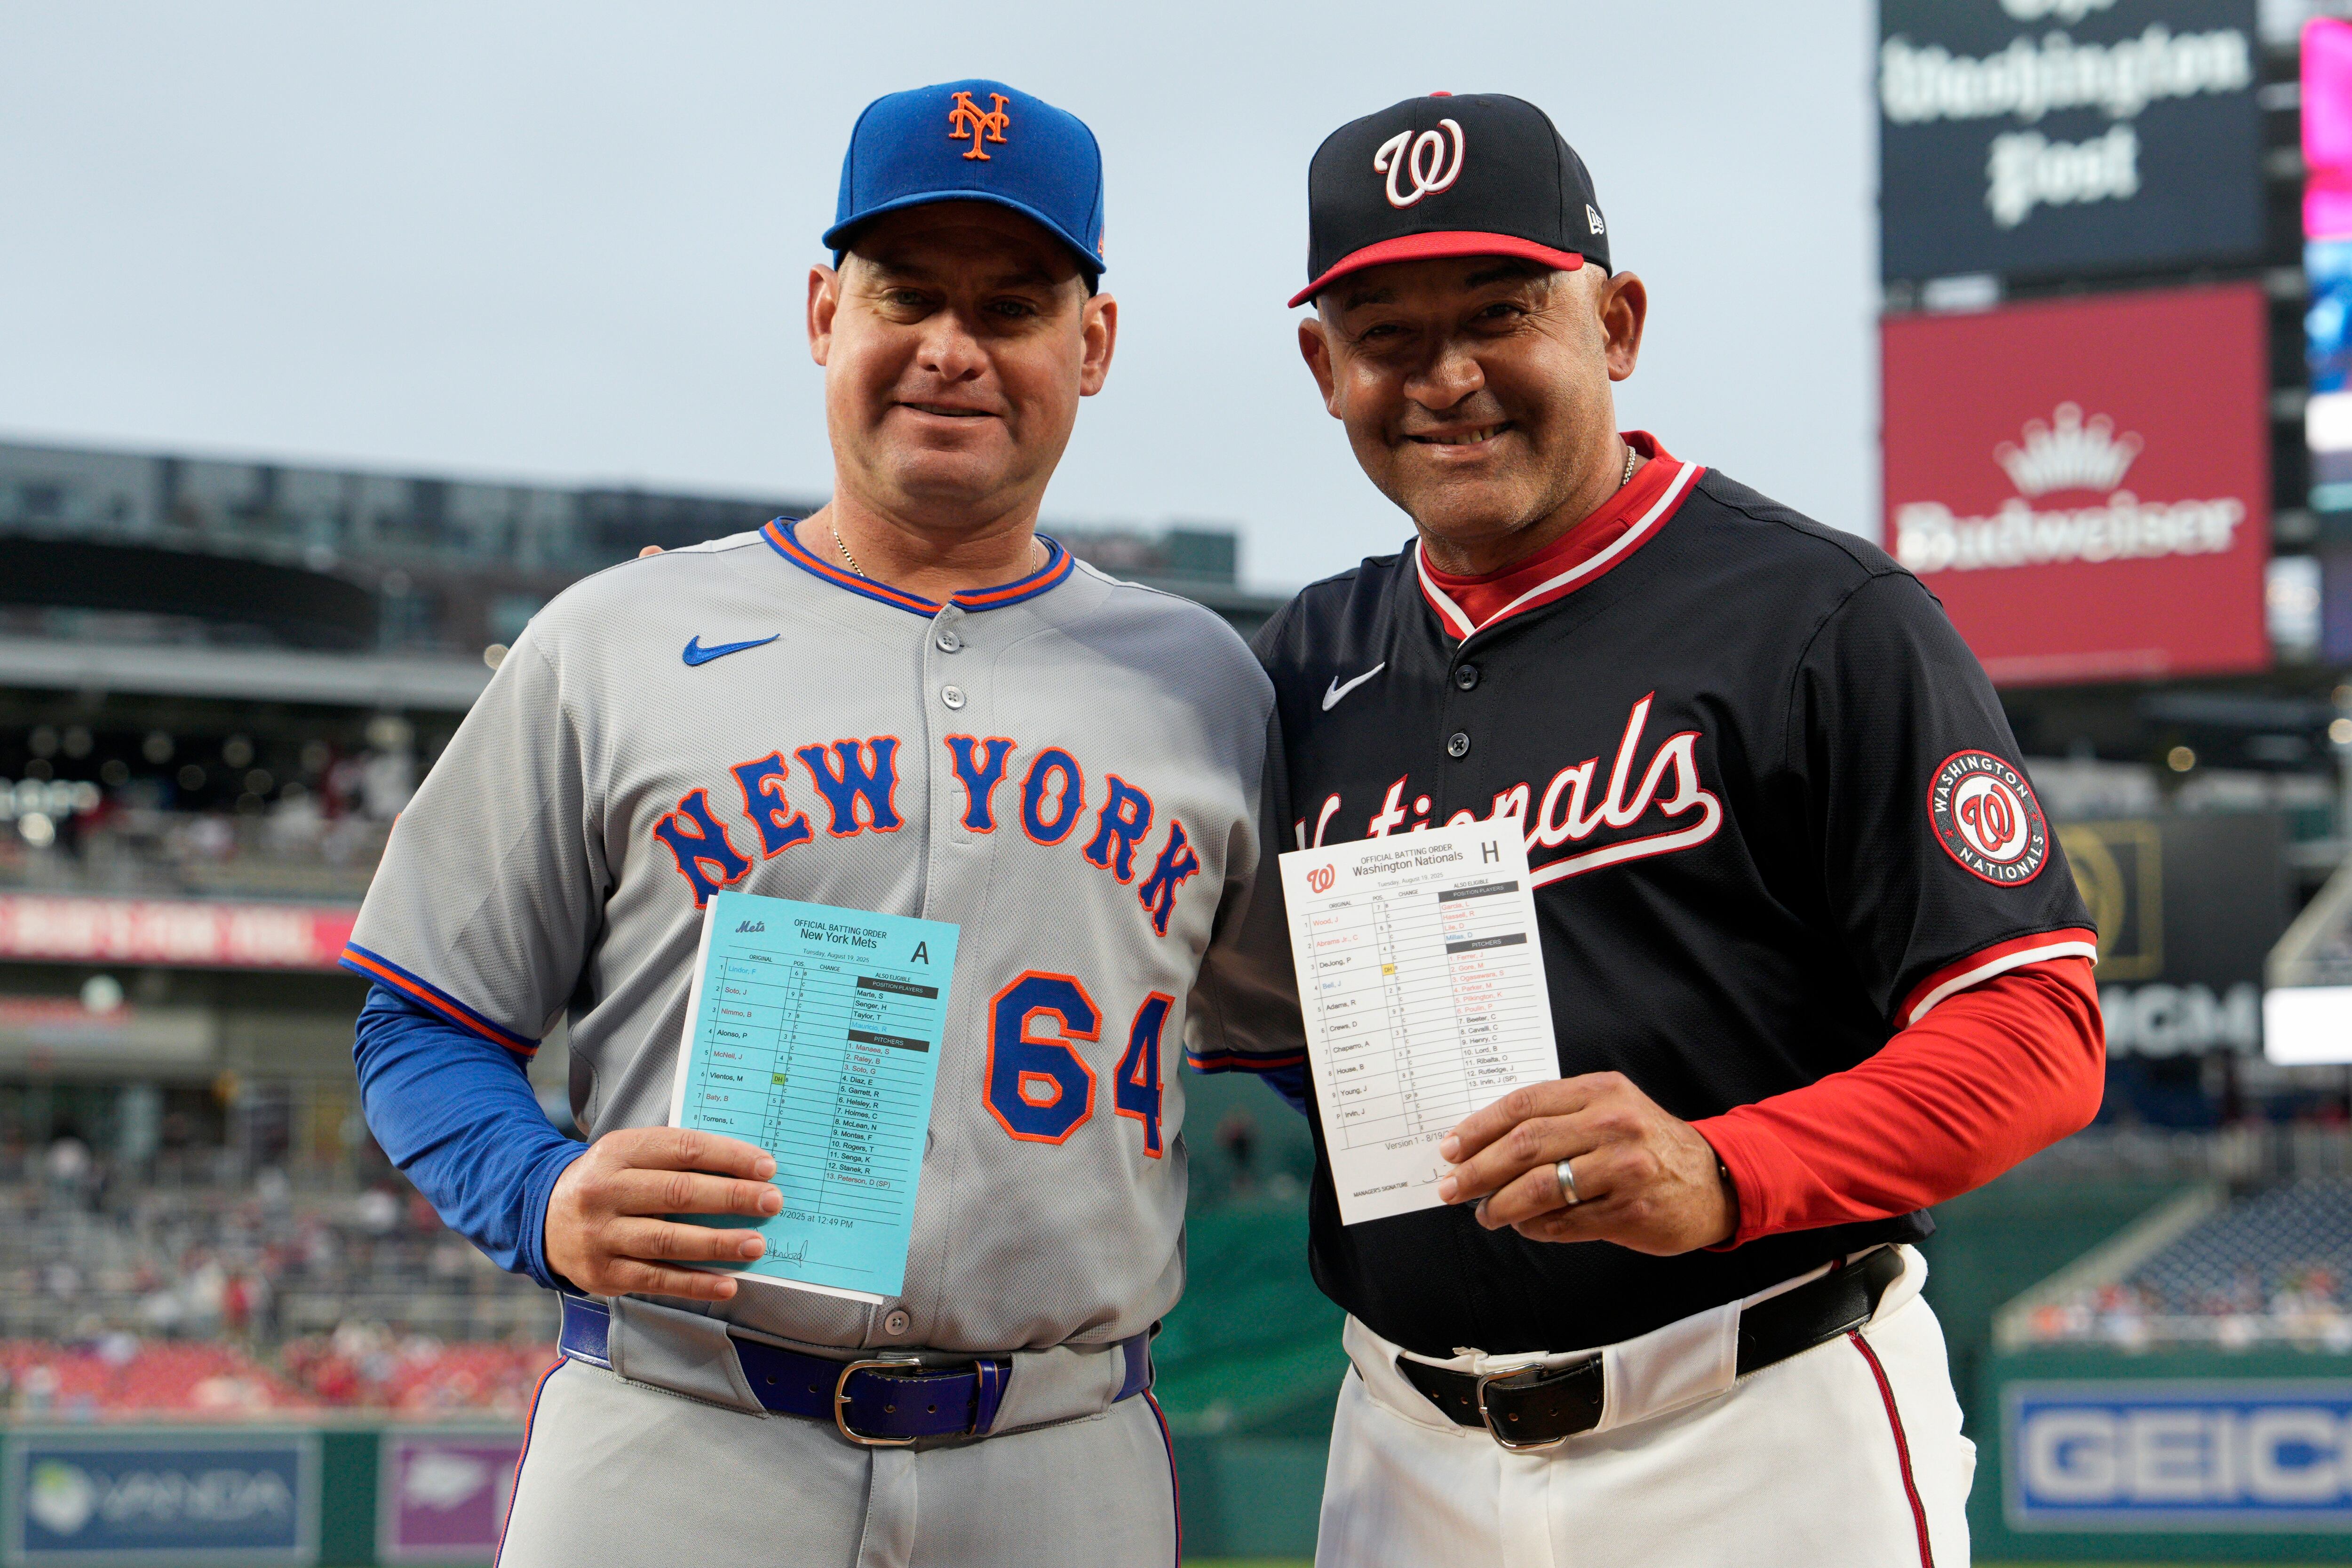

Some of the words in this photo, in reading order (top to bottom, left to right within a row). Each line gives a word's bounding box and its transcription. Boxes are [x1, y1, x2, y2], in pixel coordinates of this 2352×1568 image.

[1374, 119, 1465, 209] W
[1934, 756, 2028, 812] WASHINGTON
[1961, 783, 2015, 852] W
[653, 734, 905, 909] NEW
[943, 733, 1199, 937] YORK
[1361, 853, 1393, 864] OFFICIAL
[1395, 847, 1427, 859] BATTING
[1429, 844, 1453, 853] ORDER
[1960, 835, 2044, 879] NATIONALS
[1352, 860, 1412, 876] Washington
[1415, 852, 1463, 866] Nationals
[1468, 878, 1489, 887] ELIGIBLE
[1453, 889, 1479, 898] POSITION
[1479, 885, 1504, 894] PLAYERS
[735, 921, 765, 933] Mets
[794, 919, 826, 930] OFFICIAL
[829, 924, 861, 935] BATTING
[863, 929, 887, 939] ORDER
[801, 928, 823, 940] New
[826, 931, 849, 945] York
[851, 936, 877, 948] Mets
[1471, 939, 1502, 949] PITCHERS
[803, 948, 826, 957] Tuesday,
[910, 941, 929, 964] A
[725, 987, 741, 995] Soto,
[872, 981, 898, 990] POSITION
[898, 985, 923, 994] PLAYERS
[857, 989, 877, 999] Marte,
[855, 1000, 879, 1010] Senger,
[721, 1008, 745, 1017] Nimmo,
[854, 1011, 874, 1020] Taylor,
[717, 1029, 740, 1038] Alonso,
[874, 1036, 904, 1046] PITCHERS
[855, 1044, 884, 1054] Manaea,
[713, 1051, 736, 1060] McNeil,
[854, 1055, 873, 1064] Raley,
[983, 969, 1176, 1159] 64
[852, 1066, 868, 1074] Soto,
[710, 1072, 735, 1081] Vientos,
[850, 1076, 866, 1085] Diaz,
[849, 1087, 872, 1097] Garrett,
[706, 1093, 722, 1102] Baty,
[846, 1098, 871, 1108] Helsley,
[844, 1109, 870, 1119] Holmes,
[703, 1115, 728, 1124] Torrens,
[842, 1120, 869, 1130] McLean,
[841, 1130, 866, 1140] Montas,
[843, 1142, 867, 1152] Rogers,
[1385, 1140, 1413, 1150] Version
[841, 1153, 863, 1162] Senga,
[839, 1164, 863, 1174] Stanek,
[837, 1174, 867, 1185] Peterson,
[876, 1180, 890, 1189] (SP)
[1382, 1181, 1408, 1192] SIGNATURE
[818, 1216, 838, 1226] 12:49
[840, 1219, 853, 1228] PM
[2027, 1412, 2352, 1502] GEIC
